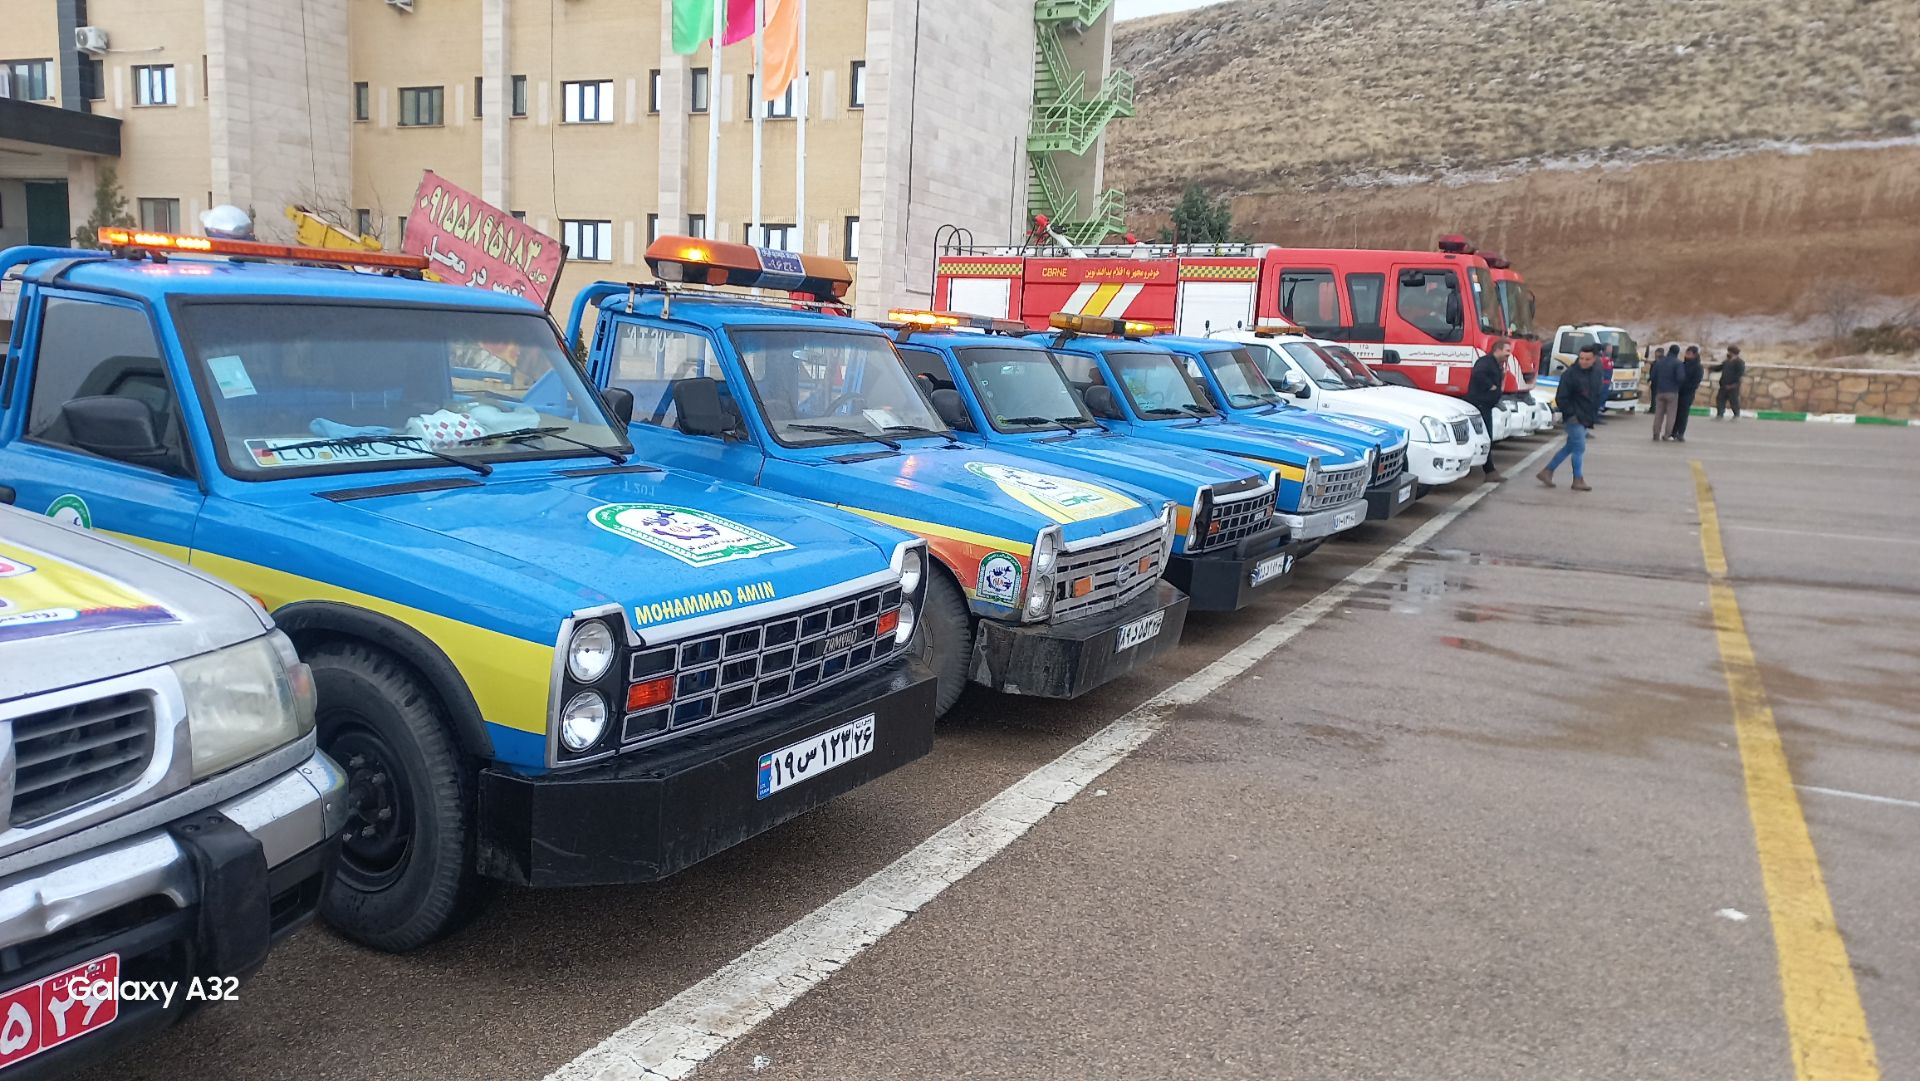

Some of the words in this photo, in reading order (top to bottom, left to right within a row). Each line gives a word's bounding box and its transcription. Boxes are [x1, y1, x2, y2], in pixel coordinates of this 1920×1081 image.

[1041, 267, 1068, 278] CBRNE
[634, 588, 733, 625] MOHAMMAD
[736, 580, 776, 604] AMIN
